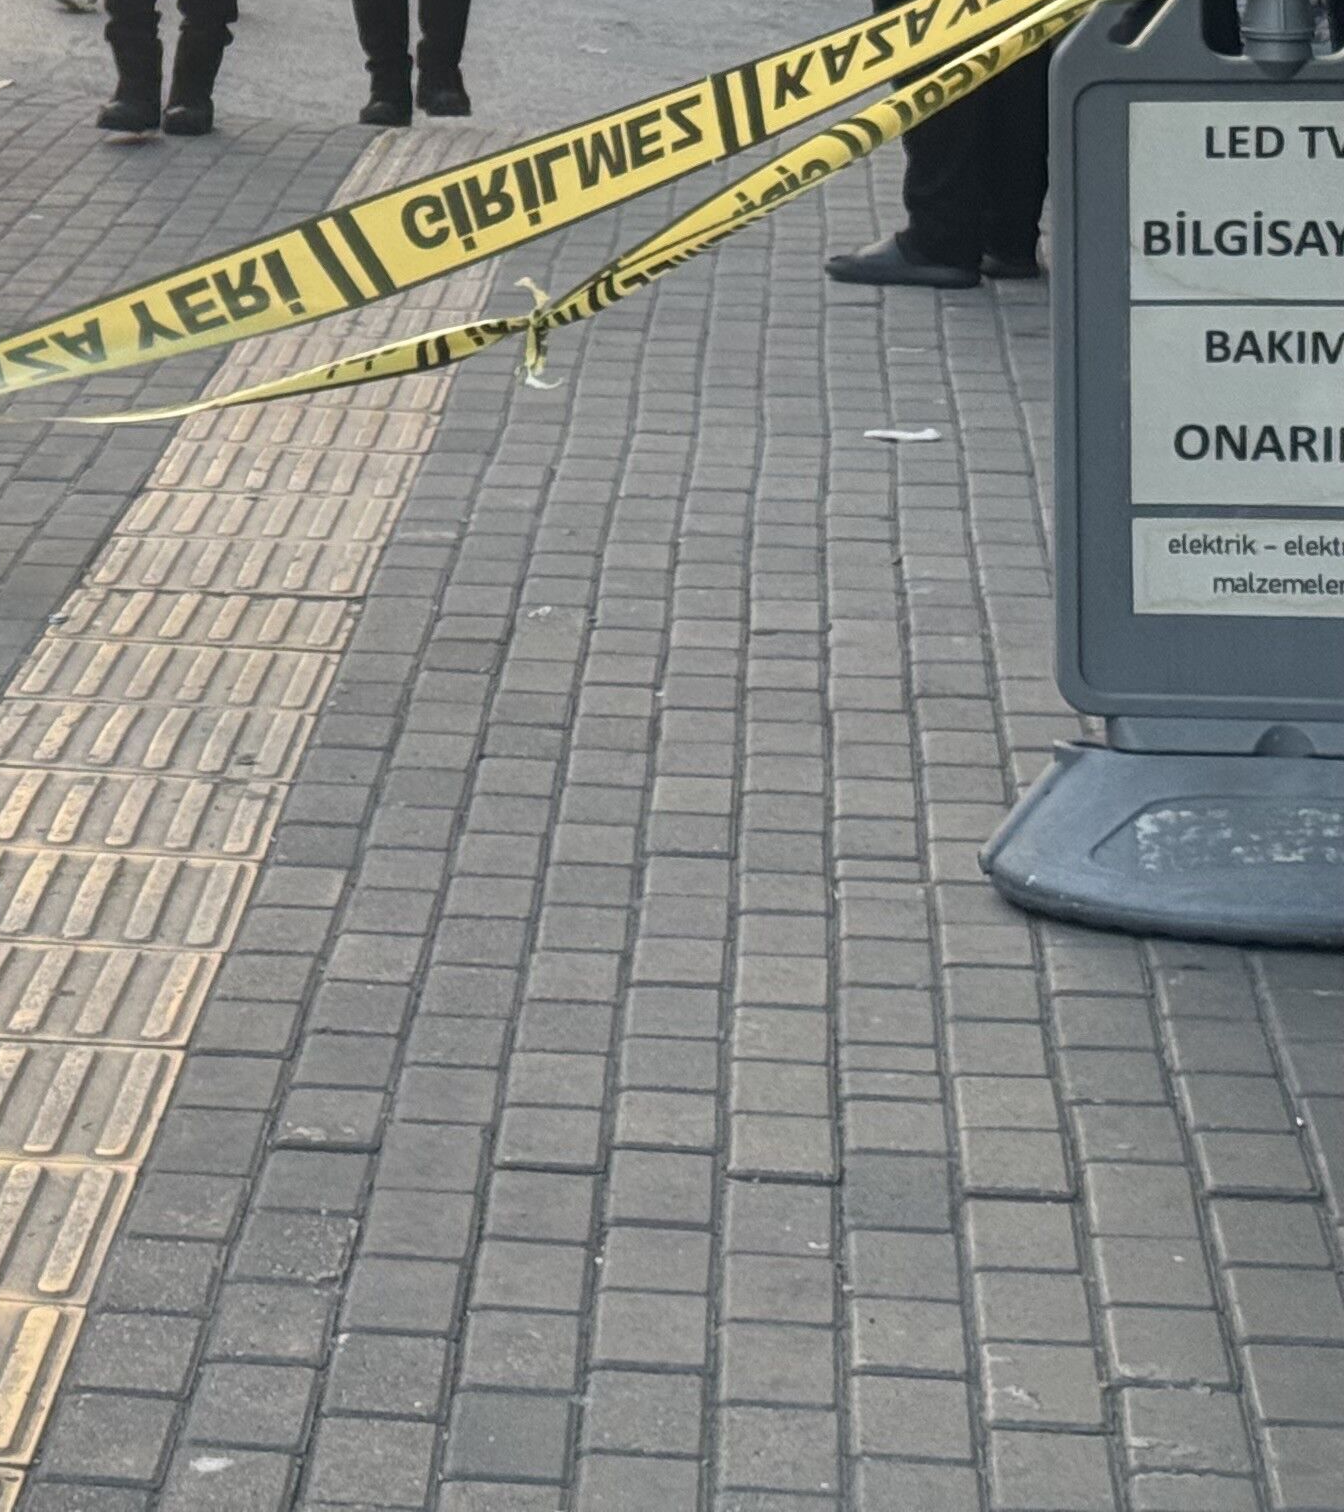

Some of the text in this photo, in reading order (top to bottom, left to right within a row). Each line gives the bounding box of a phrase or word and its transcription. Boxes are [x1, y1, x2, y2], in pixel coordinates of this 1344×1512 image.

[1205, 125, 1344, 159] LED TV
[1205, 330, 1344, 364] BAKIM
[1173, 424, 1344, 463] ONARI
[1168, 533, 1257, 555] elektrik
[1284, 535, 1344, 557] elekt
